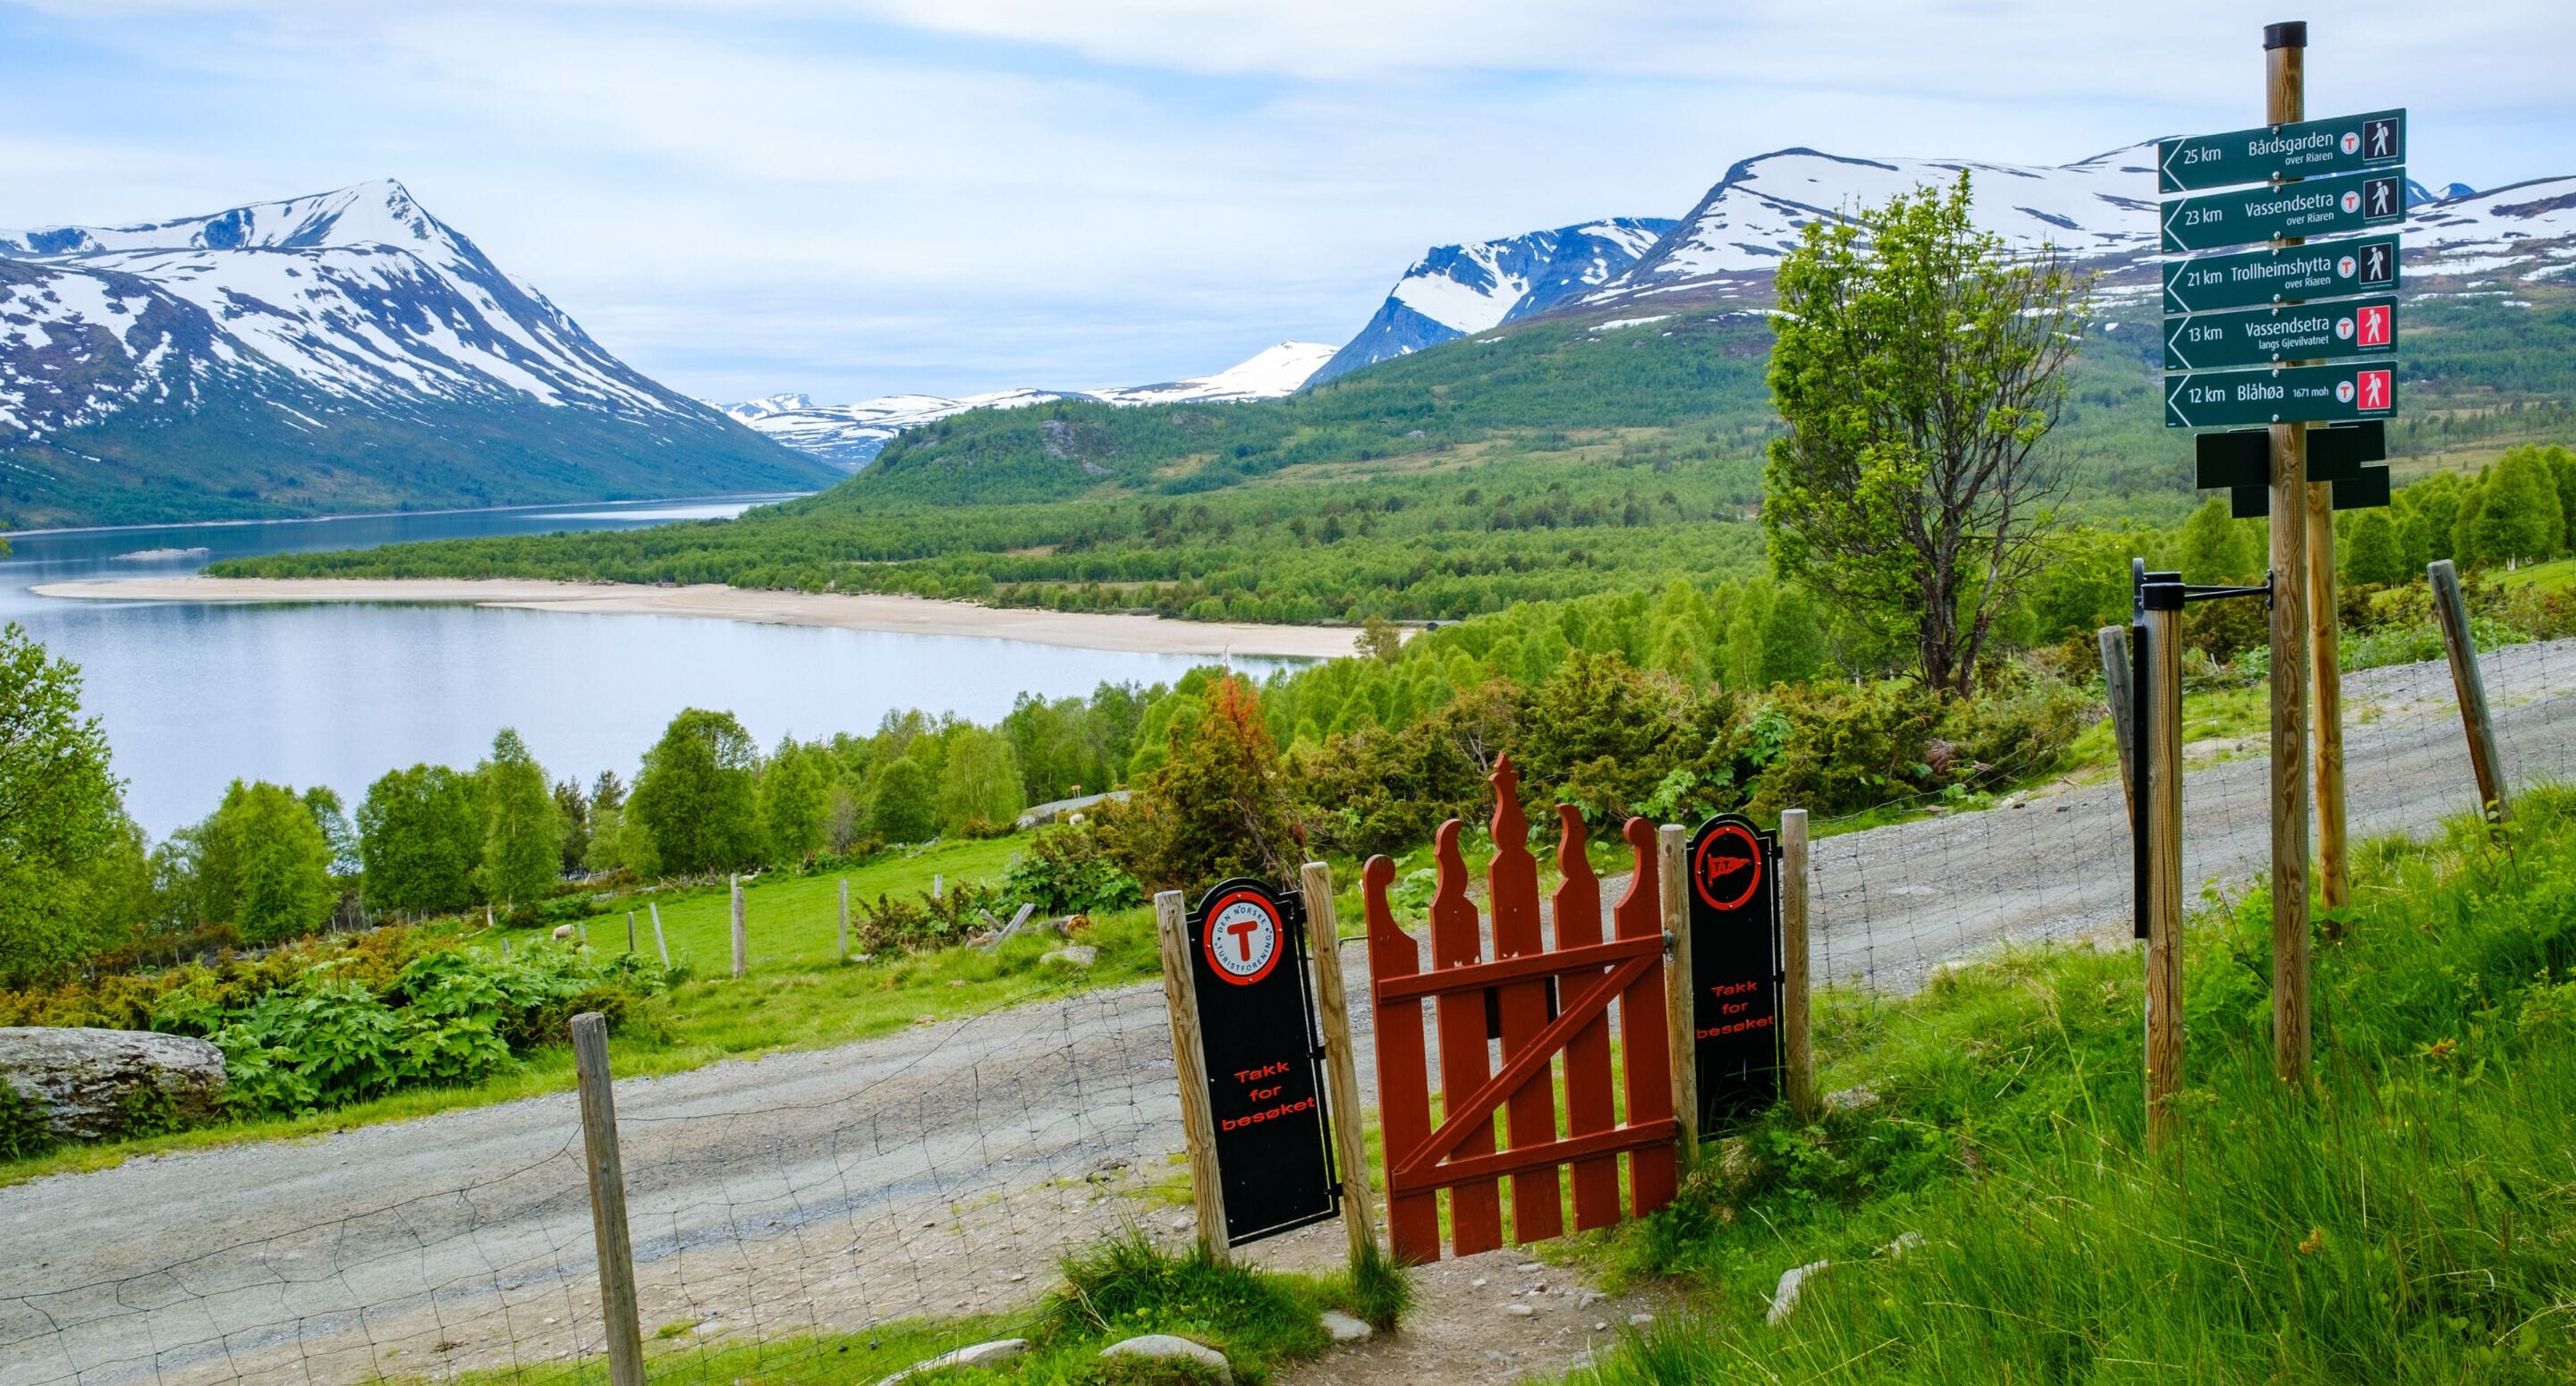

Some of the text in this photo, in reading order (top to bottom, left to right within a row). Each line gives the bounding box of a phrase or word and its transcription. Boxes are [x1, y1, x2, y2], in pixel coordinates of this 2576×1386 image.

[2183, 131, 2334, 165] 25 km Bårdsgarden
[2285, 151, 2334, 166] over Riaren
[2185, 193, 2334, 225] 23 km Vassendsetra
[2286, 211, 2334, 226] over Riaren
[2188, 257, 2331, 287] 21 km Trollheimshytta
[2285, 275, 2331, 290] over Riaren
[2189, 317, 2329, 342] 13 km Vassendsetra
[2258, 335, 2329, 351] langs Gjevilvatnet
[2189, 383, 2329, 403] 12 km Blåhøa 1671 moh
[1219, 906, 1267, 933] DEN NORSKE
[1216, 934, 1272, 972] TURISTFORENING
[1227, 920, 1258, 962] T
[1710, 981, 1758, 997] Takk
[1722, 1001, 1749, 1016] for
[1696, 1015, 1775, 1040] besøket
[1233, 1061, 1290, 1084] Takk
[1250, 1086, 1282, 1102] for
[1222, 1096, 1316, 1131] besøket
